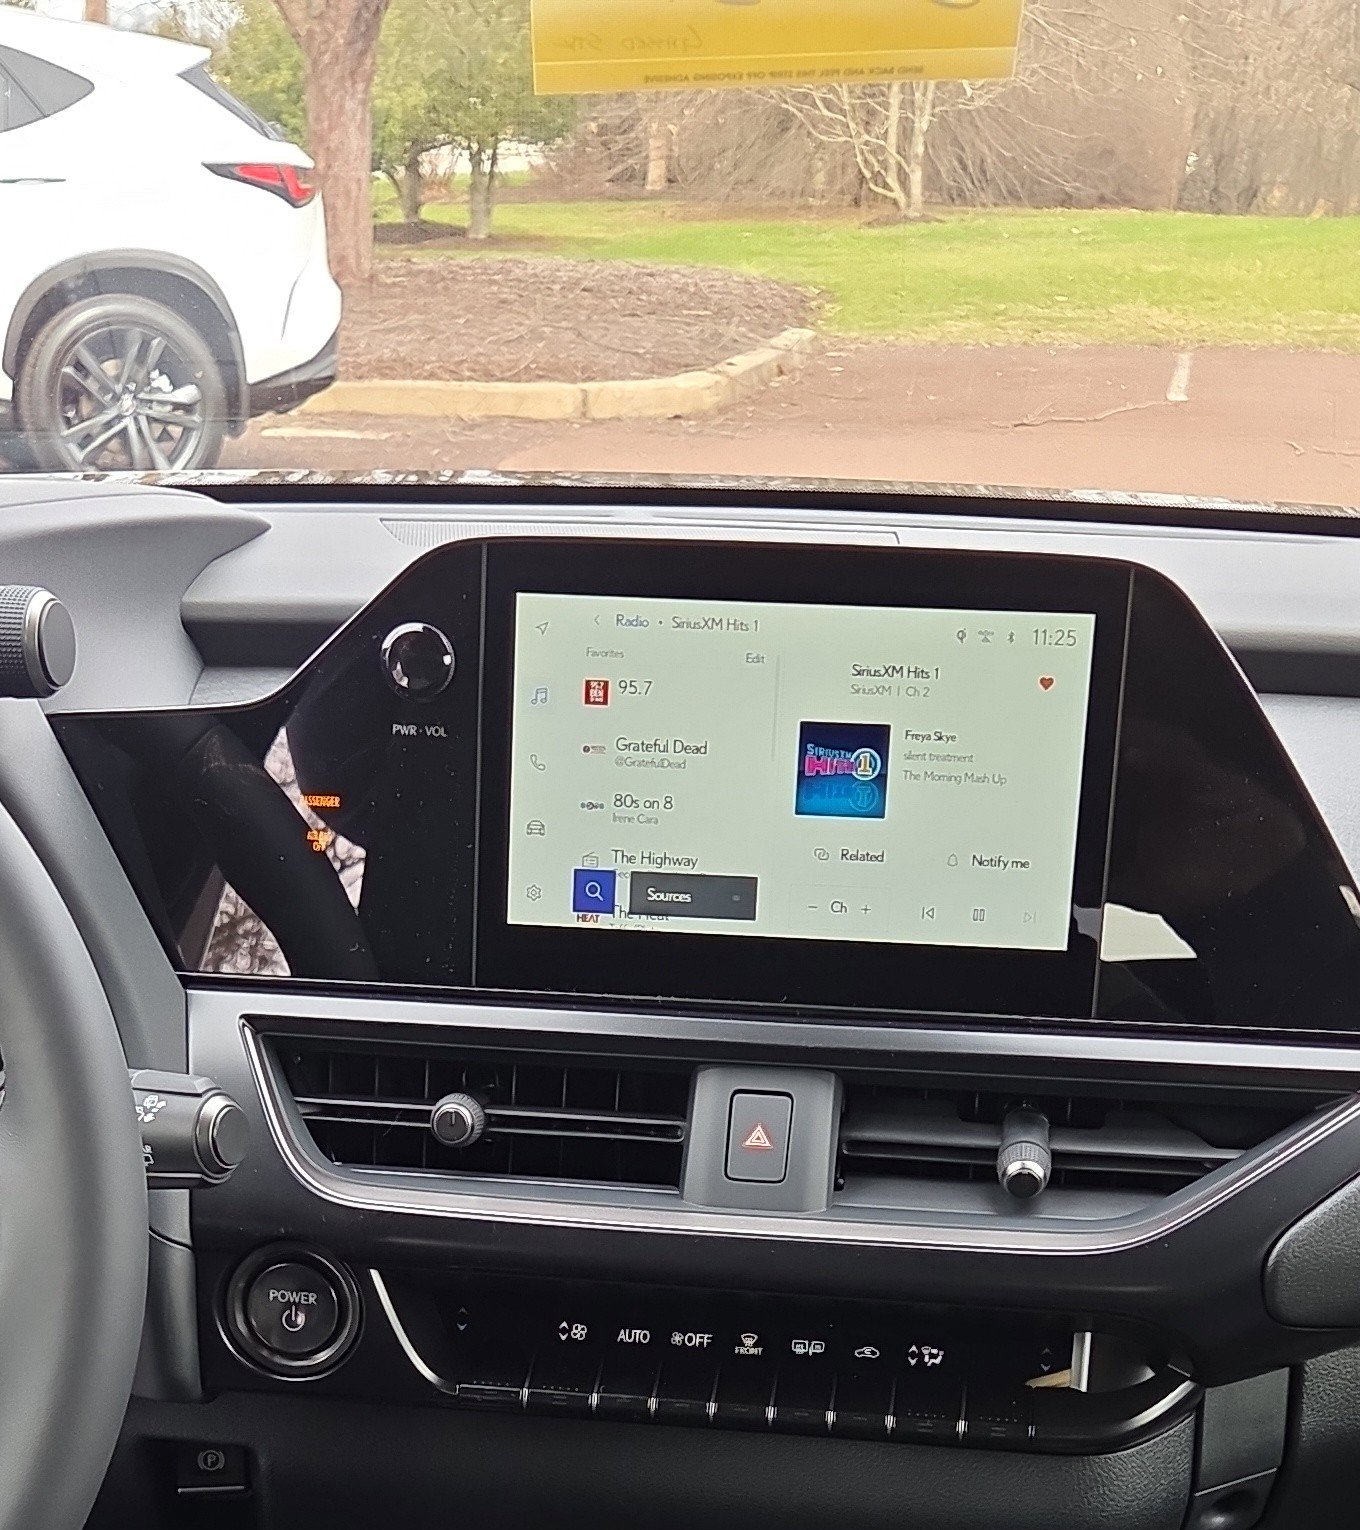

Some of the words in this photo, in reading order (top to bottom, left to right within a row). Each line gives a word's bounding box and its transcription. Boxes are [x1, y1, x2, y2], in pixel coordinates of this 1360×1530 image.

[616, 613, 650, 629] Radio
[671, 616, 724, 631] SiriusXM
[726, 618, 750, 632] Hits
[753, 619, 759, 632] 1
[1033, 629, 1078, 647] 11:25
[585, 647, 625, 659] Favorites
[745, 653, 766, 665] Edit
[851, 664, 904, 679] SiriusXM
[907, 665, 931, 680] Hits
[934, 667, 940, 680] 1
[618, 679, 653, 696] 95.7
[905, 685, 921, 698] Ch
[923, 686, 931, 698] 2
[392, 723, 417, 737] PWR
[424, 725, 448, 739] VOL
[904, 730, 932, 744] Freya
[933, 731, 957, 744] Skye
[615, 737, 670, 755] Grateful
[673, 740, 708, 755] Dead
[903, 770, 922, 782] The
[992, 773, 1008, 787] Up
[613, 794, 640, 810] 80s
[643, 797, 660, 810] on
[663, 795, 674, 811] 8
[612, 812, 635, 824] Irene
[637, 813, 659, 826] Cara
[612, 849, 637, 865] The
[640, 851, 699, 870] Highway
[840, 848, 885, 863] Related
[971, 854, 1009, 870] Notify
[1011, 858, 1030, 869] me
[646, 887, 692, 903] Sources
[830, 901, 848, 914] Ch
[576, 914, 600, 924] HEAT
[269, 1288, 318, 1306] POWER
[617, 1328, 651, 1345] AUTO
[684, 1333, 713, 1348] OFF
